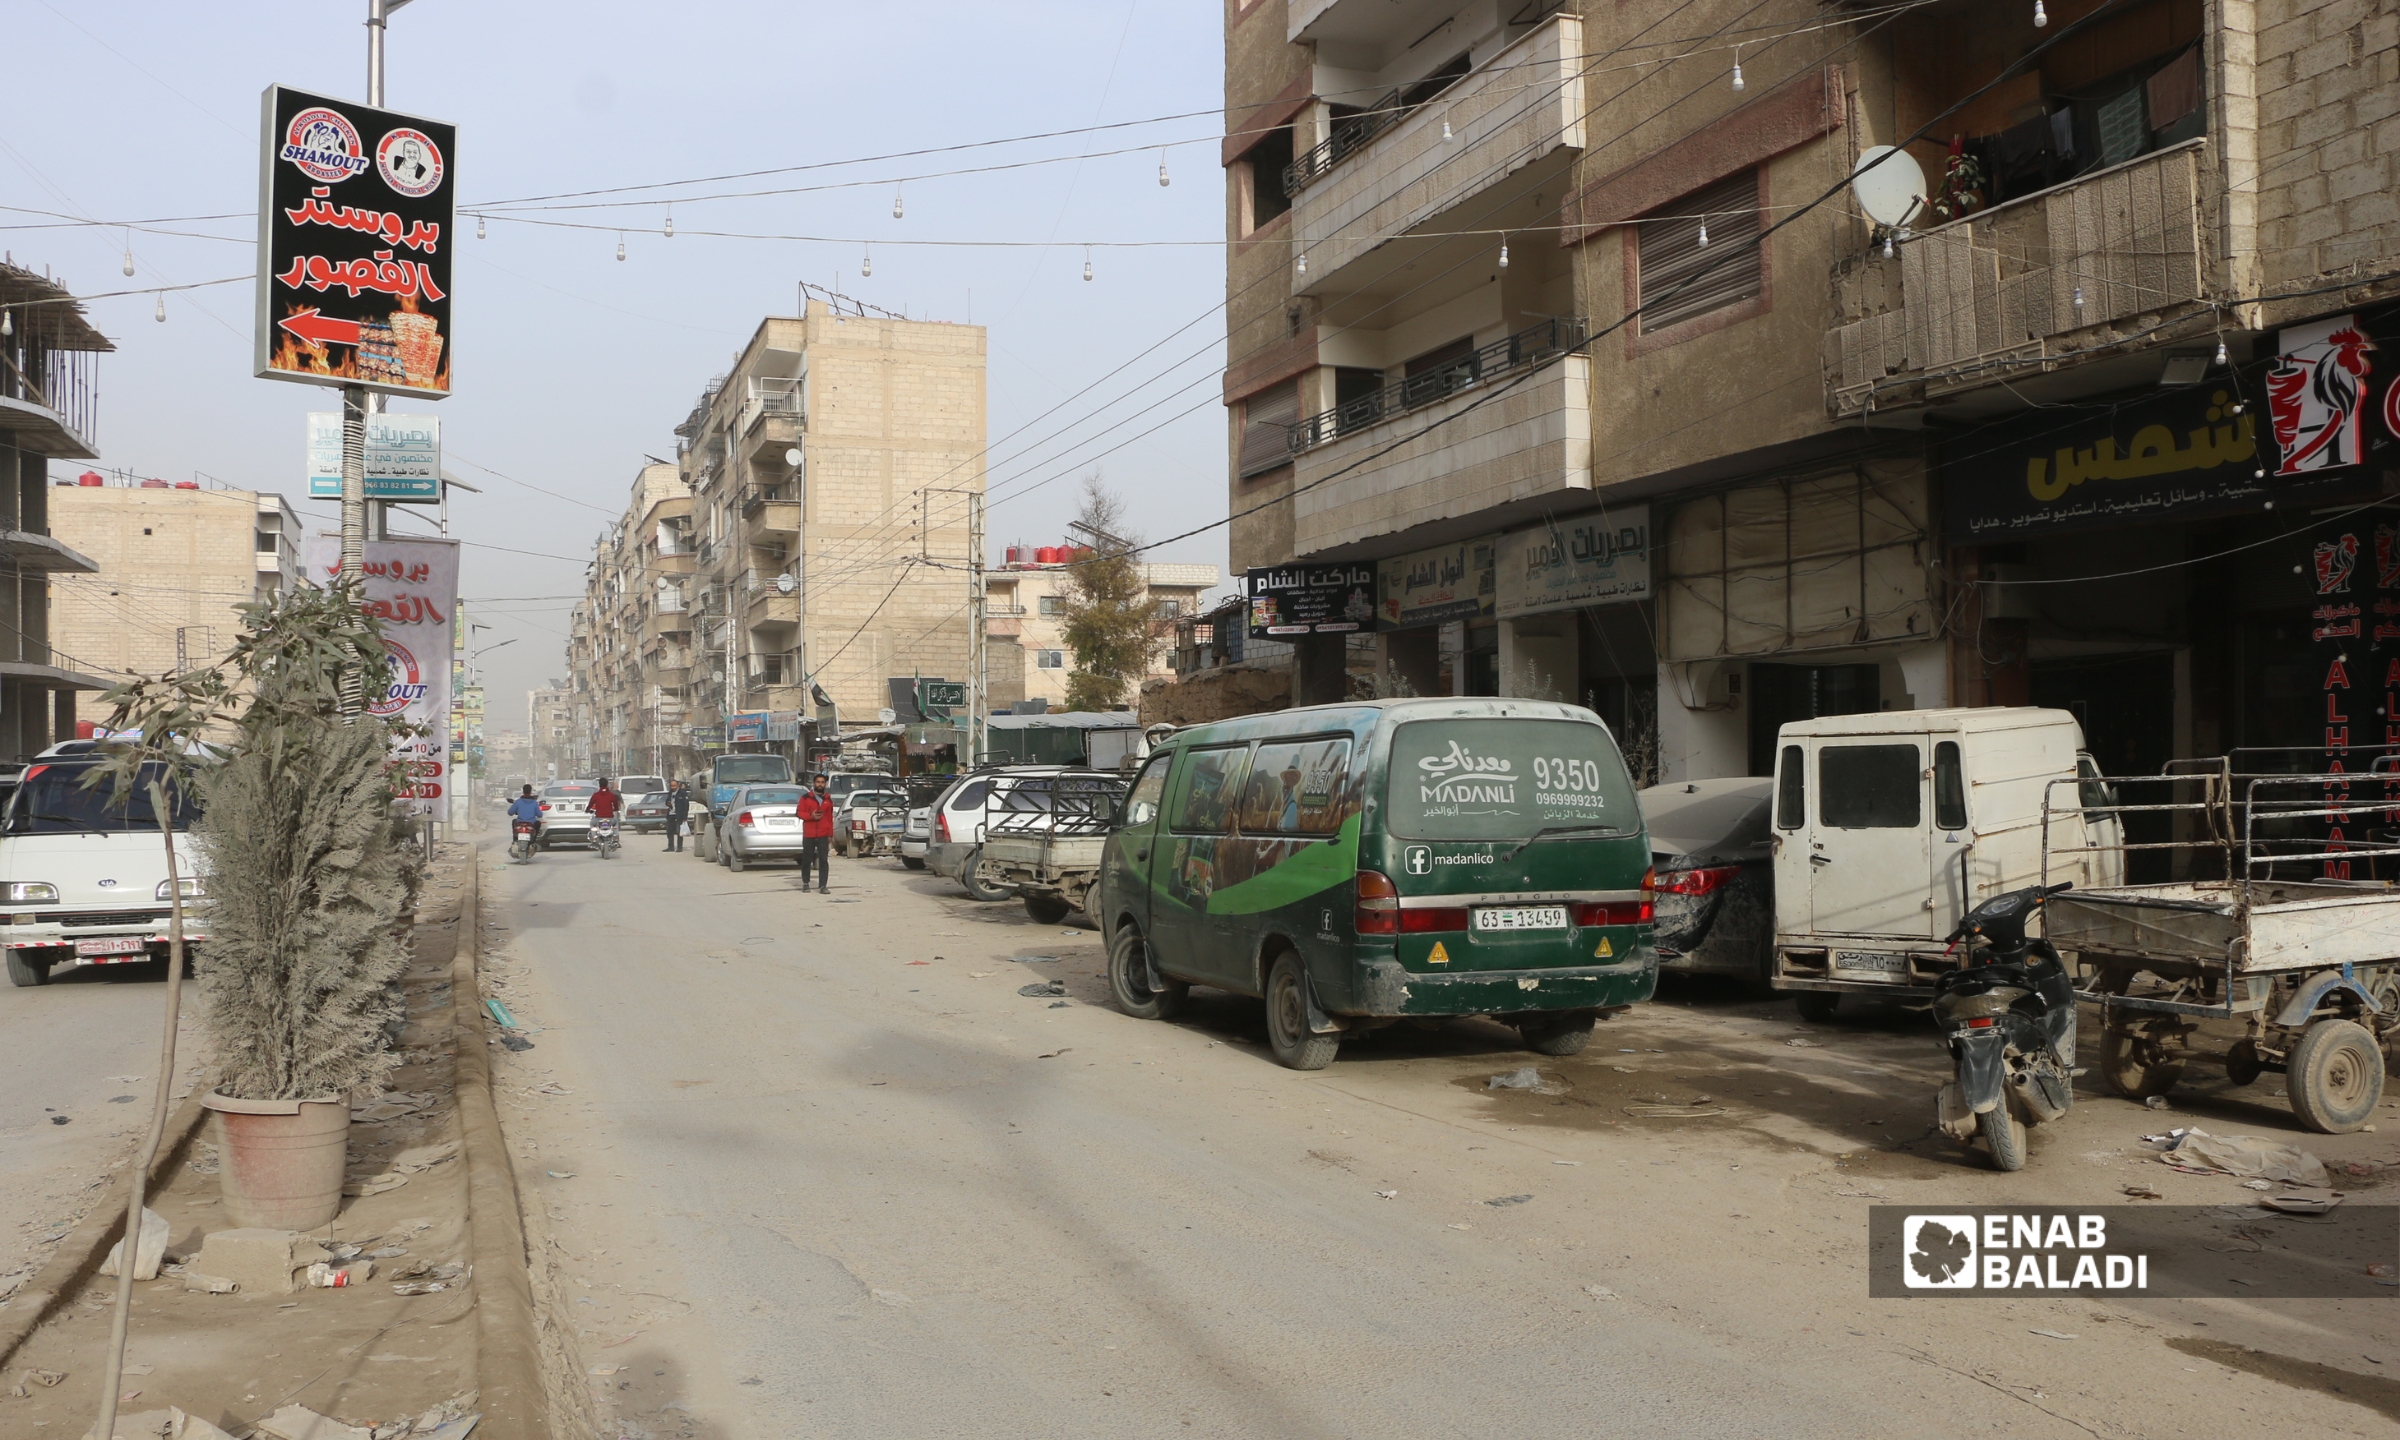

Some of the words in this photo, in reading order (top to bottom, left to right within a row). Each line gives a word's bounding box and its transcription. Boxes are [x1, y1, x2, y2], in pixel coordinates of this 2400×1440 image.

[330, 116, 356, 145] CHICKEN
[283, 145, 366, 171] SHAMOUT
[306, 164, 343, 178] BROASTED
[275, 249, 446, 302] القصور
[369, 424, 433, 448] بصريات
[2028, 390, 2256, 501] شمس
[376, 454, 391, 464] في
[394, 454, 433, 464] مختصون
[392, 466, 407, 476] طبية
[2104, 493, 2161, 514] تعليمية
[2164, 488, 2206, 508] وسائل
[2009, 507, 2050, 529] تصوير
[2051, 503, 2098, 523] استديو
[1969, 517, 2000, 531] هدايا
[1526, 526, 1568, 580] الأمير
[1571, 525, 1647, 568] بصريات
[1309, 566, 1370, 587] ماركت
[1440, 546, 1465, 588] أنوار
[1256, 569, 1305, 593] الشام
[1405, 560, 1436, 595] الشام
[1620, 580, 1646, 595] نظارات
[1566, 585, 1592, 603] شمسية
[1596, 584, 1618, 599] طبية
[2313, 602, 2360, 620] مأكولات
[2313, 618, 2360, 642] الحكم
[414, 744, 427, 753] 10
[428, 743, 441, 756] من
[1418, 740, 1511, 778] معدنلي
[1533, 757, 1599, 792] 9350
[2324, 660, 2351, 881] ALHAKAM
[1536, 792, 1604, 807] 0969999232
[1543, 809, 1574, 820] الزبائن
[1575, 809, 1600, 819] خدمة
[1434, 852, 1494, 865] madanlico
[1482, 911, 1498, 927] 63
[1517, 910, 1560, 927] 13459
